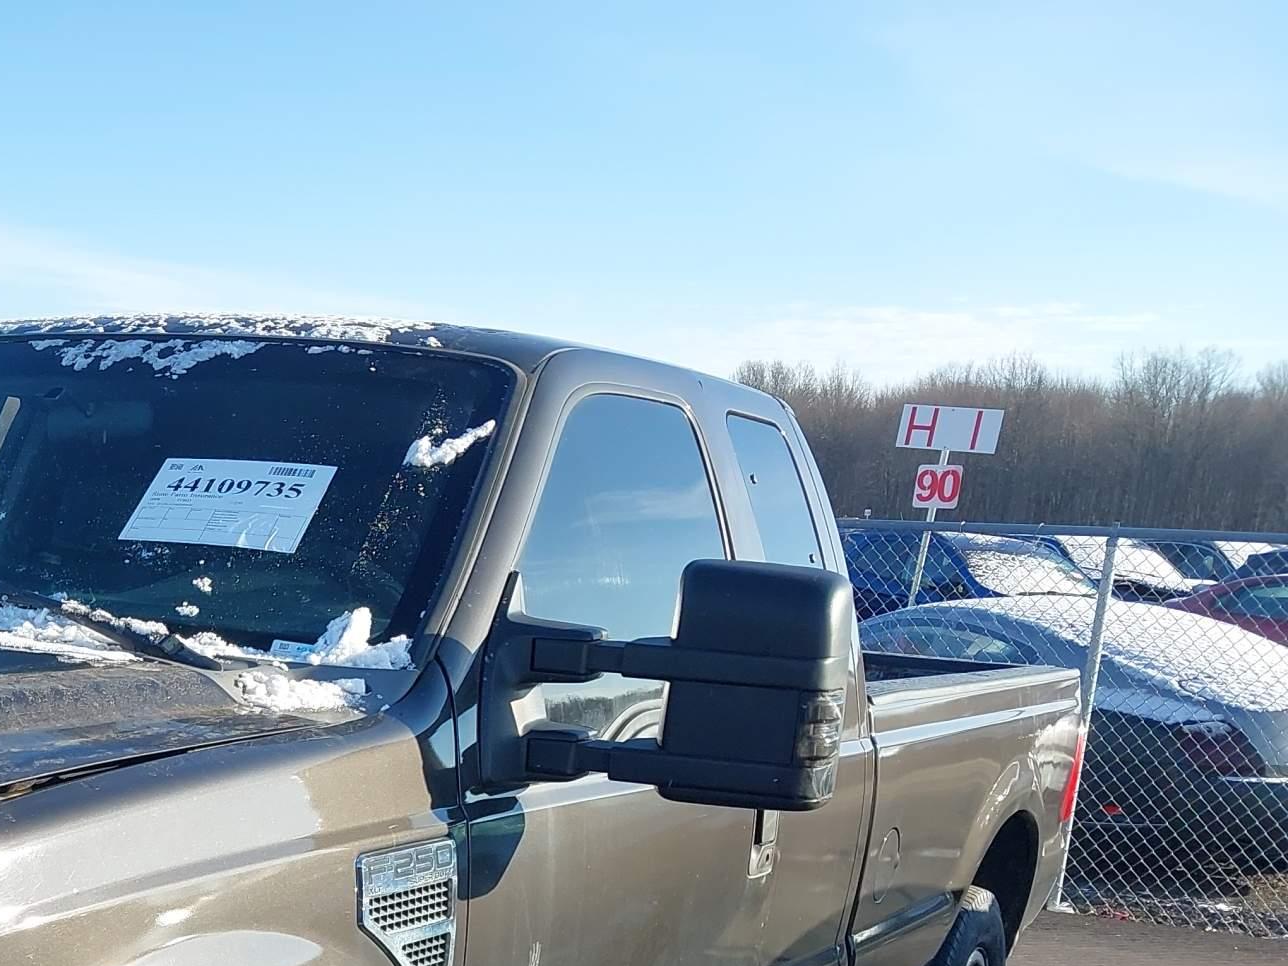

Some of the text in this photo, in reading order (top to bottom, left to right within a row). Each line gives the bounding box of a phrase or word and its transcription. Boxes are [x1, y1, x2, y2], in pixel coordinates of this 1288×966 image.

[904, 406, 940, 447] H
[166, 476, 306, 499] 44109735
[915, 469, 961, 503] 90
